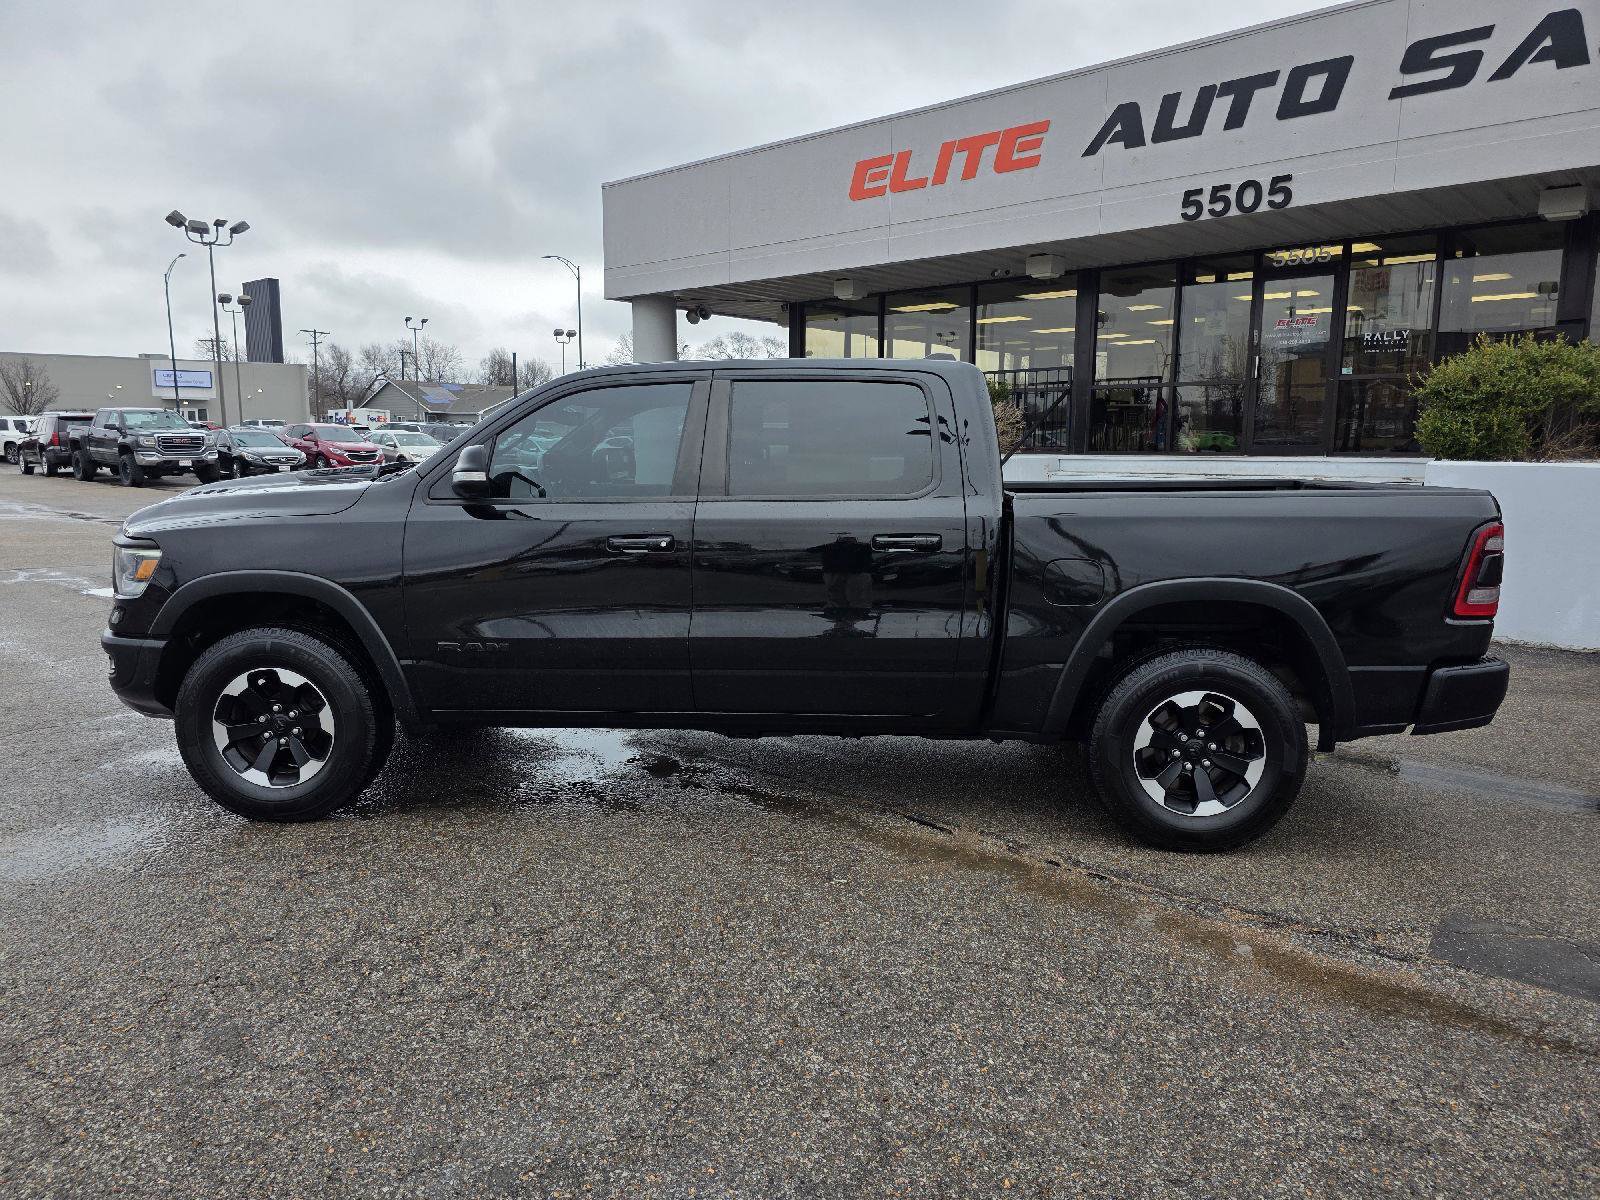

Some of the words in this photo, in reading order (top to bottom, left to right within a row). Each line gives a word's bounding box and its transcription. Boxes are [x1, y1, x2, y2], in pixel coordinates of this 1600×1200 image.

[849, 120, 1050, 201] ELITE
[1081, 55, 1355, 157] AUTO
[1388, 8, 1600, 100] SA
[1181, 174, 1293, 221] 5505
[1272, 246, 1331, 268] 5505
[1364, 329, 1410, 341] RALLY
[367, 415, 388, 423] FedEx
